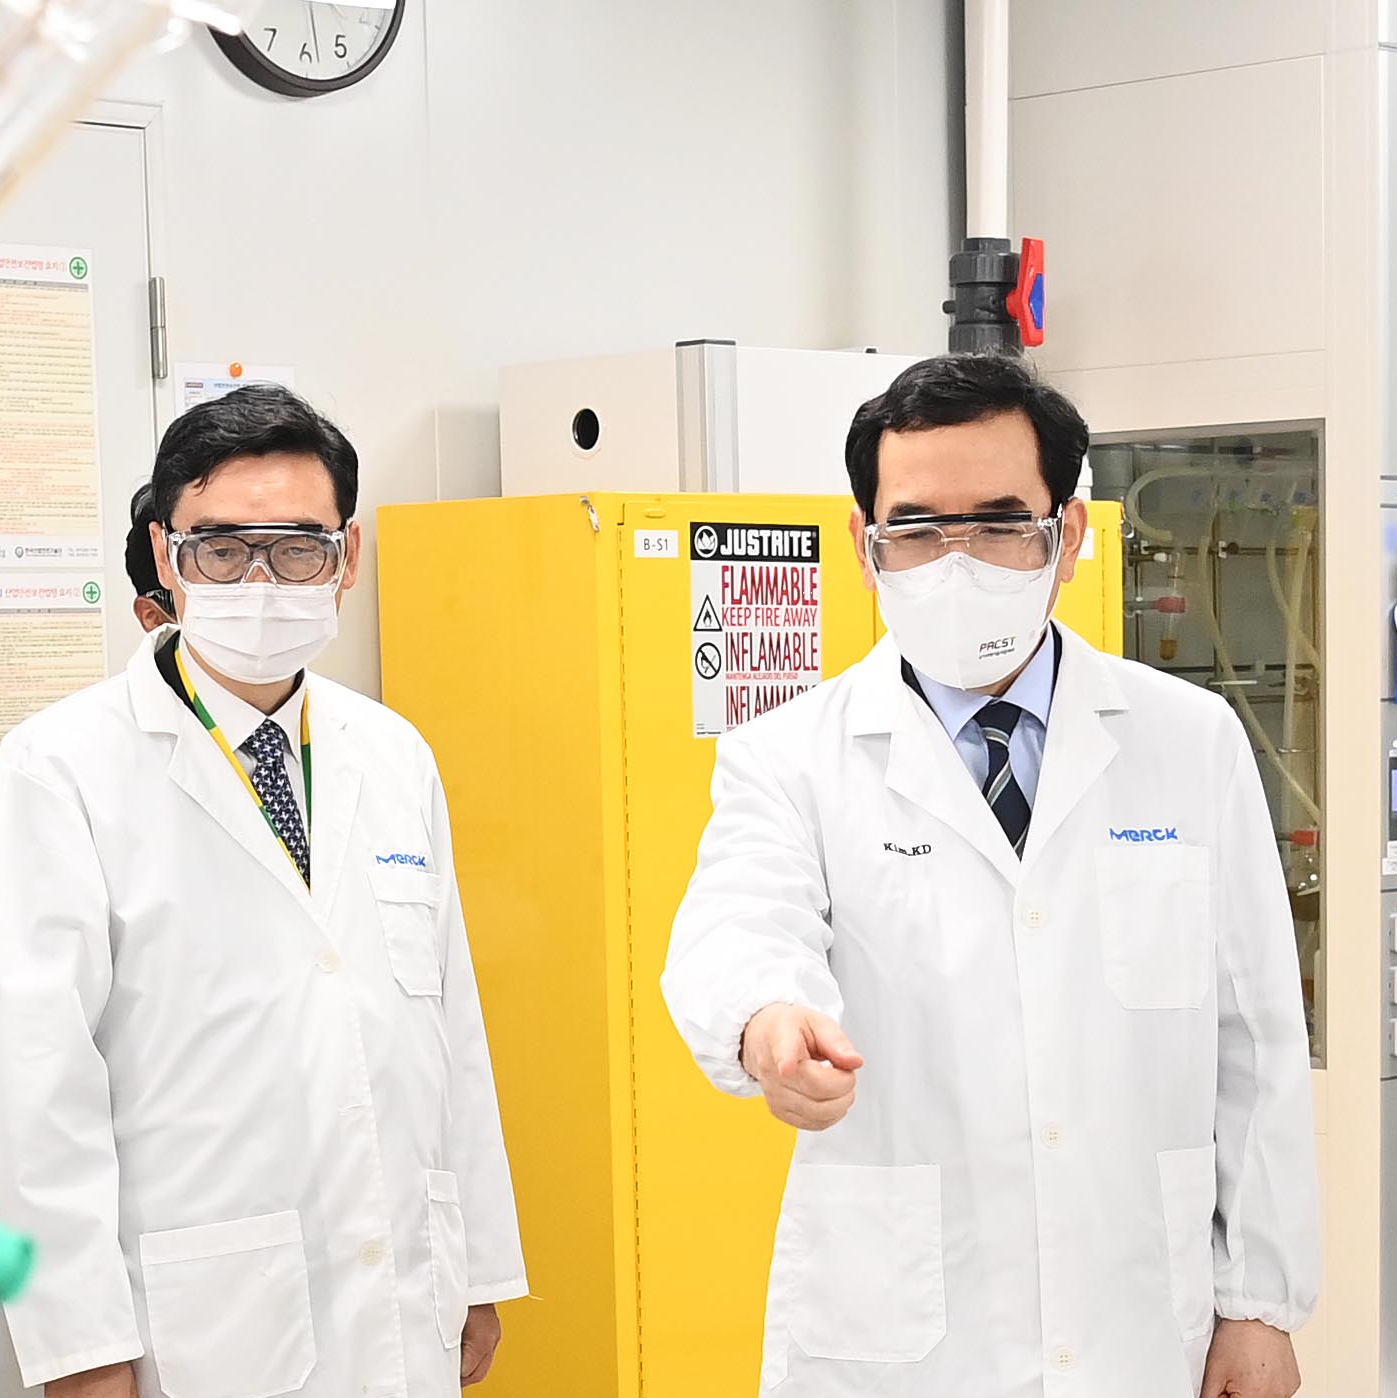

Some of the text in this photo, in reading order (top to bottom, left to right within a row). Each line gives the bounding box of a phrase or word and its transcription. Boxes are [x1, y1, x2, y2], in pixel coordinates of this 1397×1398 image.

[263, 27, 278, 52] 7
[334, 34, 348, 59] 5
[643, 537, 669, 551] B-S1
[720, 528, 812, 557] JUSTRITE
[722, 565, 818, 606] FLAMMABLE
[722, 607, 818, 627] KEEP FIRE AWAY
[725, 632, 819, 671] INFLAMABLE
[1108, 827, 1179, 842] MERCK
